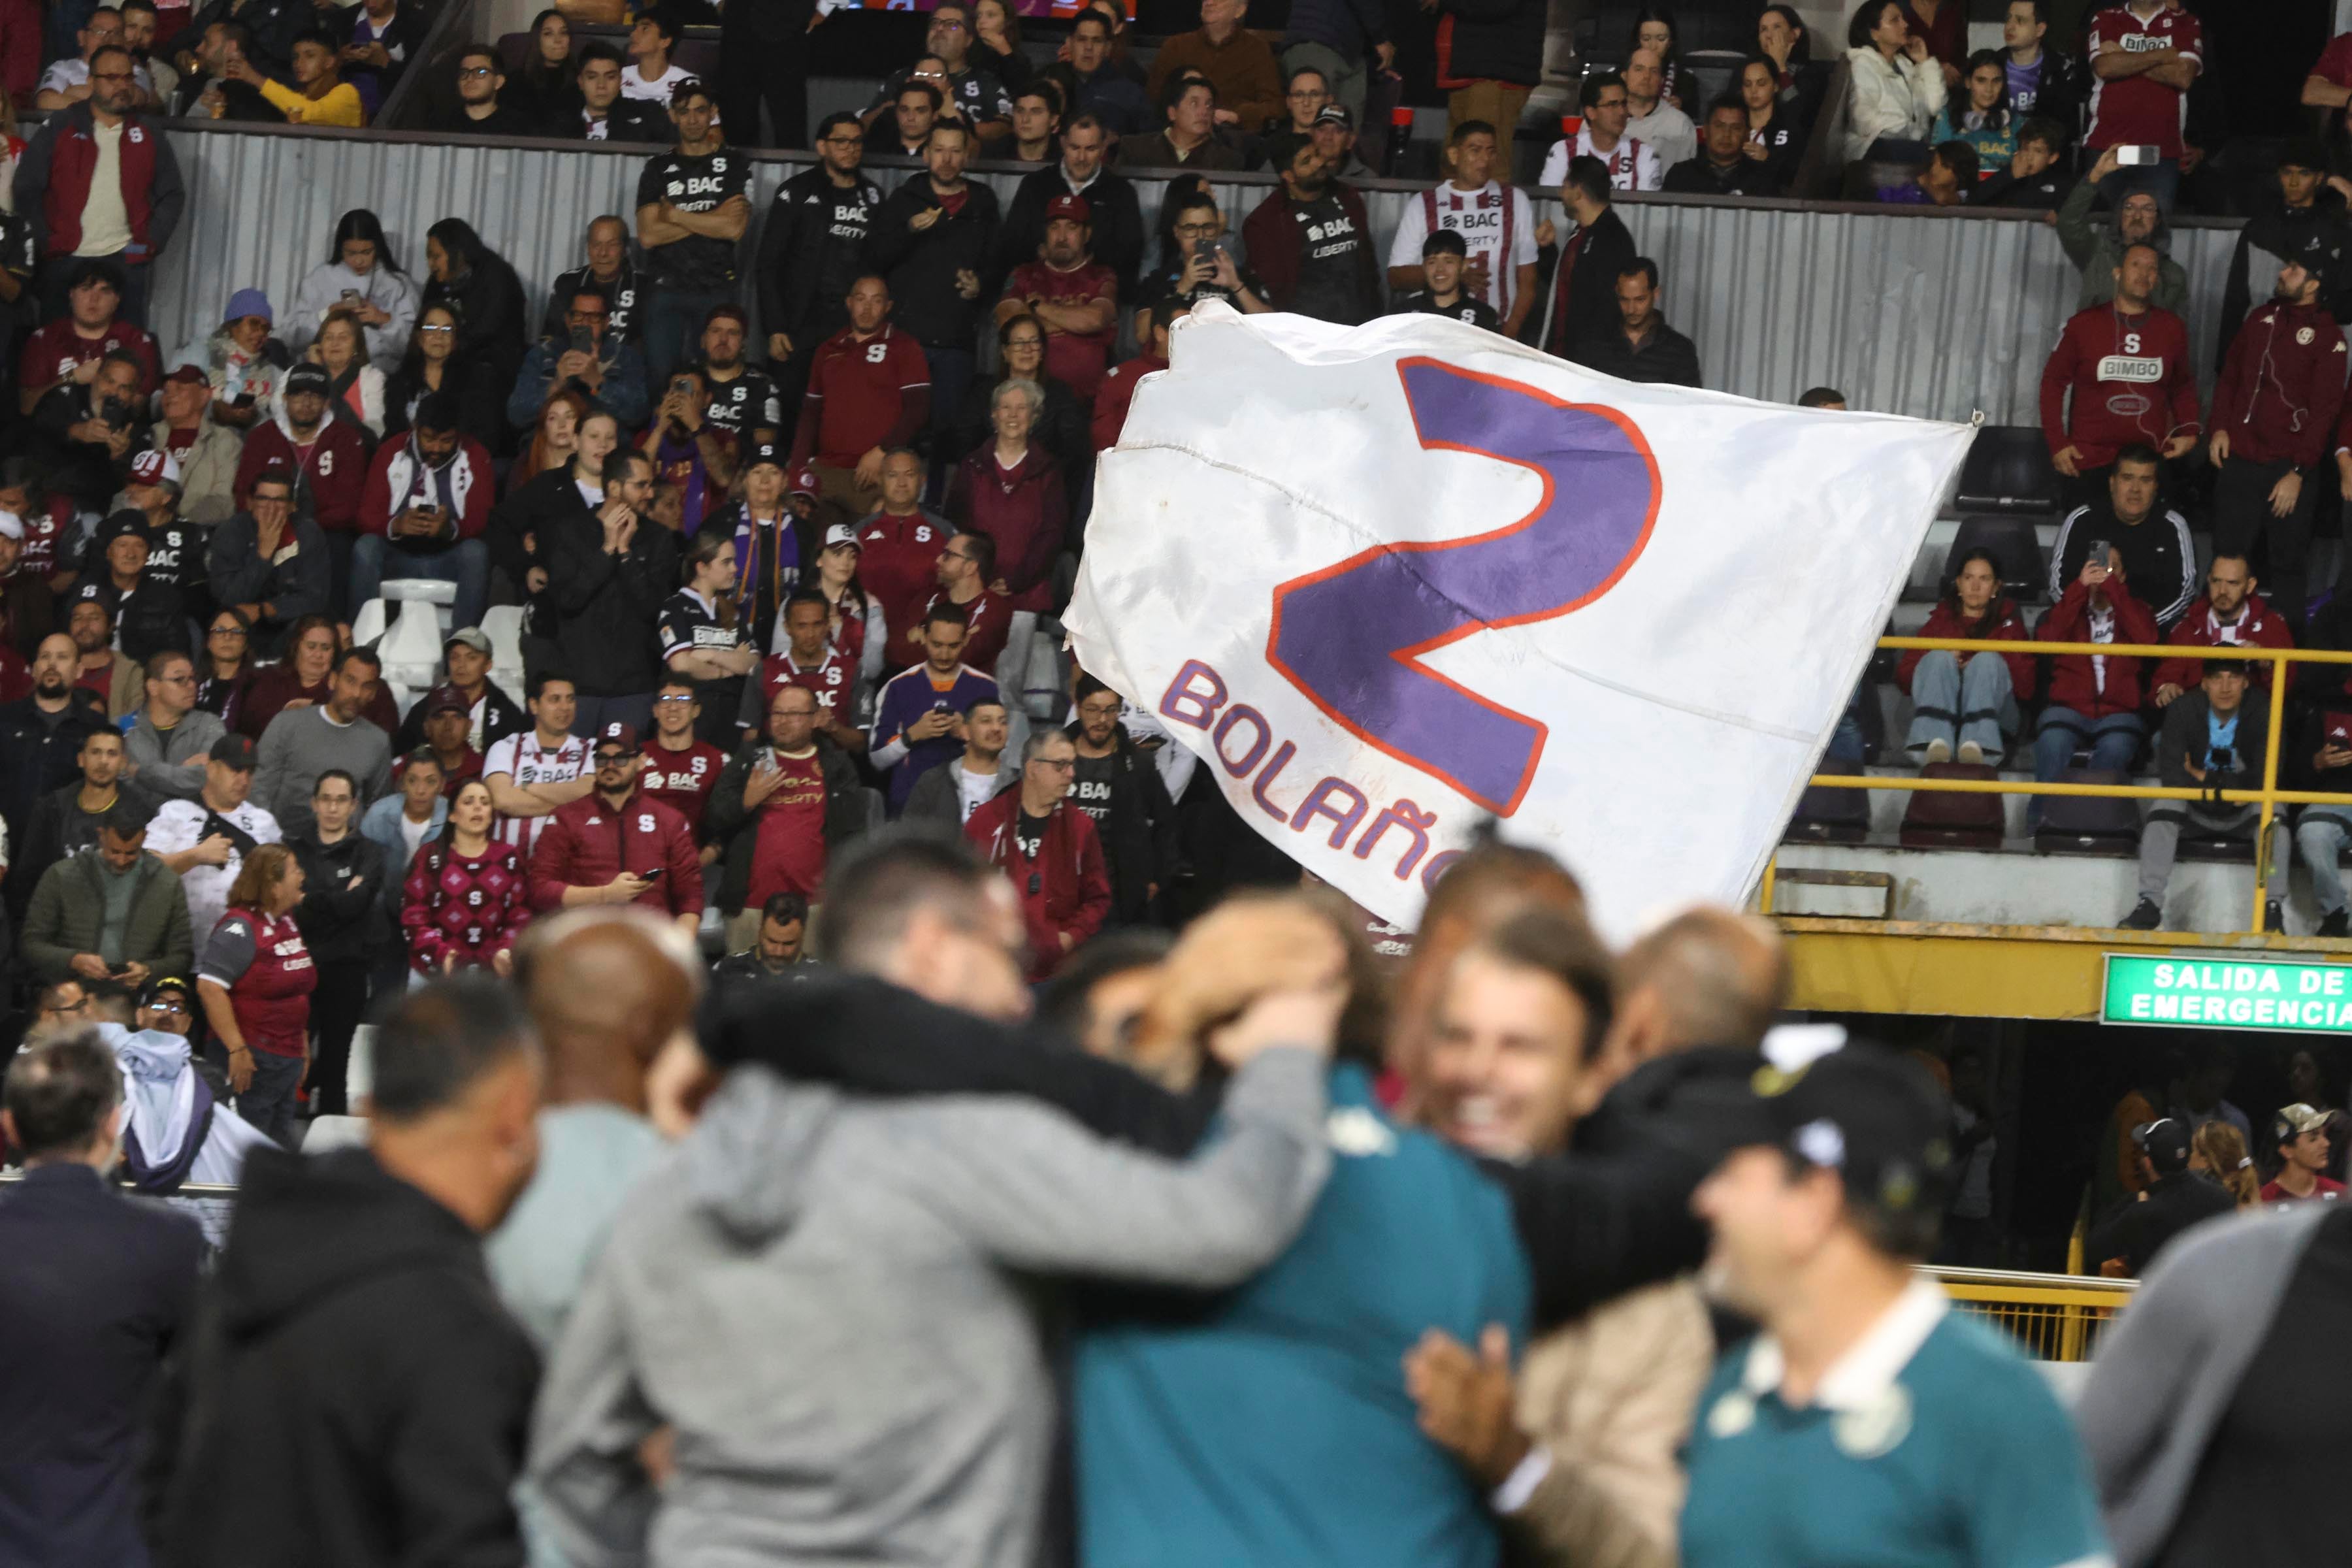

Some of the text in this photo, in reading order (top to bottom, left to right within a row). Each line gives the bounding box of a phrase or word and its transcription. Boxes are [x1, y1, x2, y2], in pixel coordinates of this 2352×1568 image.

[965, 80, 979, 97] S
[129, 127, 143, 143] S
[1774, 129, 1789, 146] S
[1979, 141, 2011, 155] BAC
[712, 157, 727, 173] S
[1619, 157, 1633, 173] S
[687, 177, 724, 194] BAC
[1488, 195, 1503, 208] S
[834, 205, 868, 223] BAC
[1463, 213, 1499, 229] BAC
[1323, 218, 1355, 238] BAC
[1313, 239, 1358, 258] LIBERTY
[1465, 235, 1498, 248] ERTY
[621, 289, 636, 308] S
[1461, 308, 1477, 324] S
[2125, 333, 2141, 353] S
[866, 344, 887, 363] S
[2104, 361, 2159, 376] BIMBO
[732, 387, 747, 402] S
[708, 403, 742, 419] BAC
[760, 445, 774, 456] S
[318, 449, 333, 476] S
[915, 525, 932, 542] S
[1266, 356, 1663, 818] 2
[825, 666, 843, 685] S
[607, 722, 622, 737] S
[691, 756, 708, 774] S
[667, 772, 702, 787] BAC
[1079, 781, 1111, 800] BA
[638, 814, 656, 833] S
[468, 891, 483, 906] S
[2153, 964, 2345, 996] SALIDA DE
[2131, 994, 2352, 1026] EMERGENCIA
